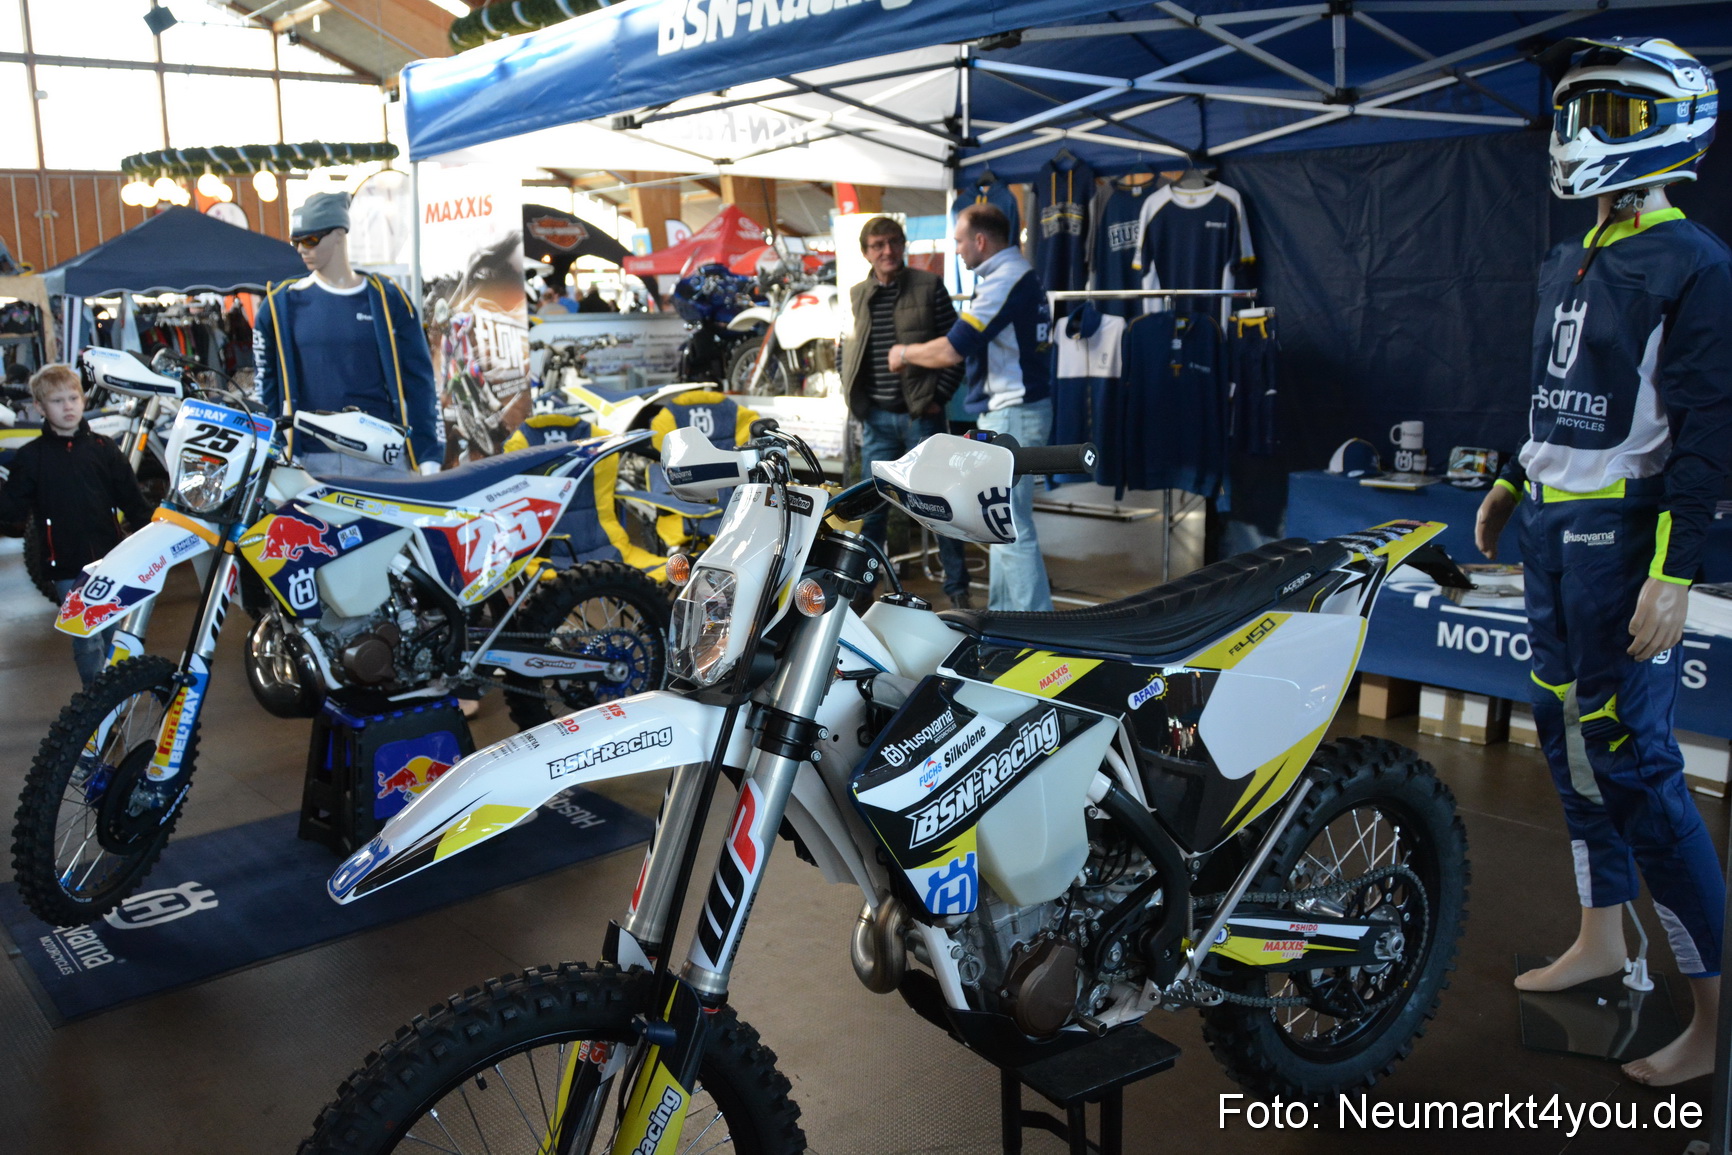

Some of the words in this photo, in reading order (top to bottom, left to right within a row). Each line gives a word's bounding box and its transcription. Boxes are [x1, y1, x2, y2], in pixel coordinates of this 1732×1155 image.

[425, 195, 493, 224] MAXXIS
[185, 423, 243, 453] 25
[456, 499, 542, 573] 25
[1569, 531, 1615, 543] Husqvarna
[138, 566, 155, 584] Red
[152, 555, 168, 573] Bull
[1039, 663, 1070, 690] MAXXIS
[1133, 682, 1161, 706] AFAM
[903, 710, 954, 755] Husqvarna
[546, 726, 672, 780] BSN-Racing
[920, 763, 943, 787] FUCHS
[944, 725, 987, 768] Silkolene
[905, 708, 1060, 849] BSN-Racing
[1264, 940, 1304, 951] MAXXIS
